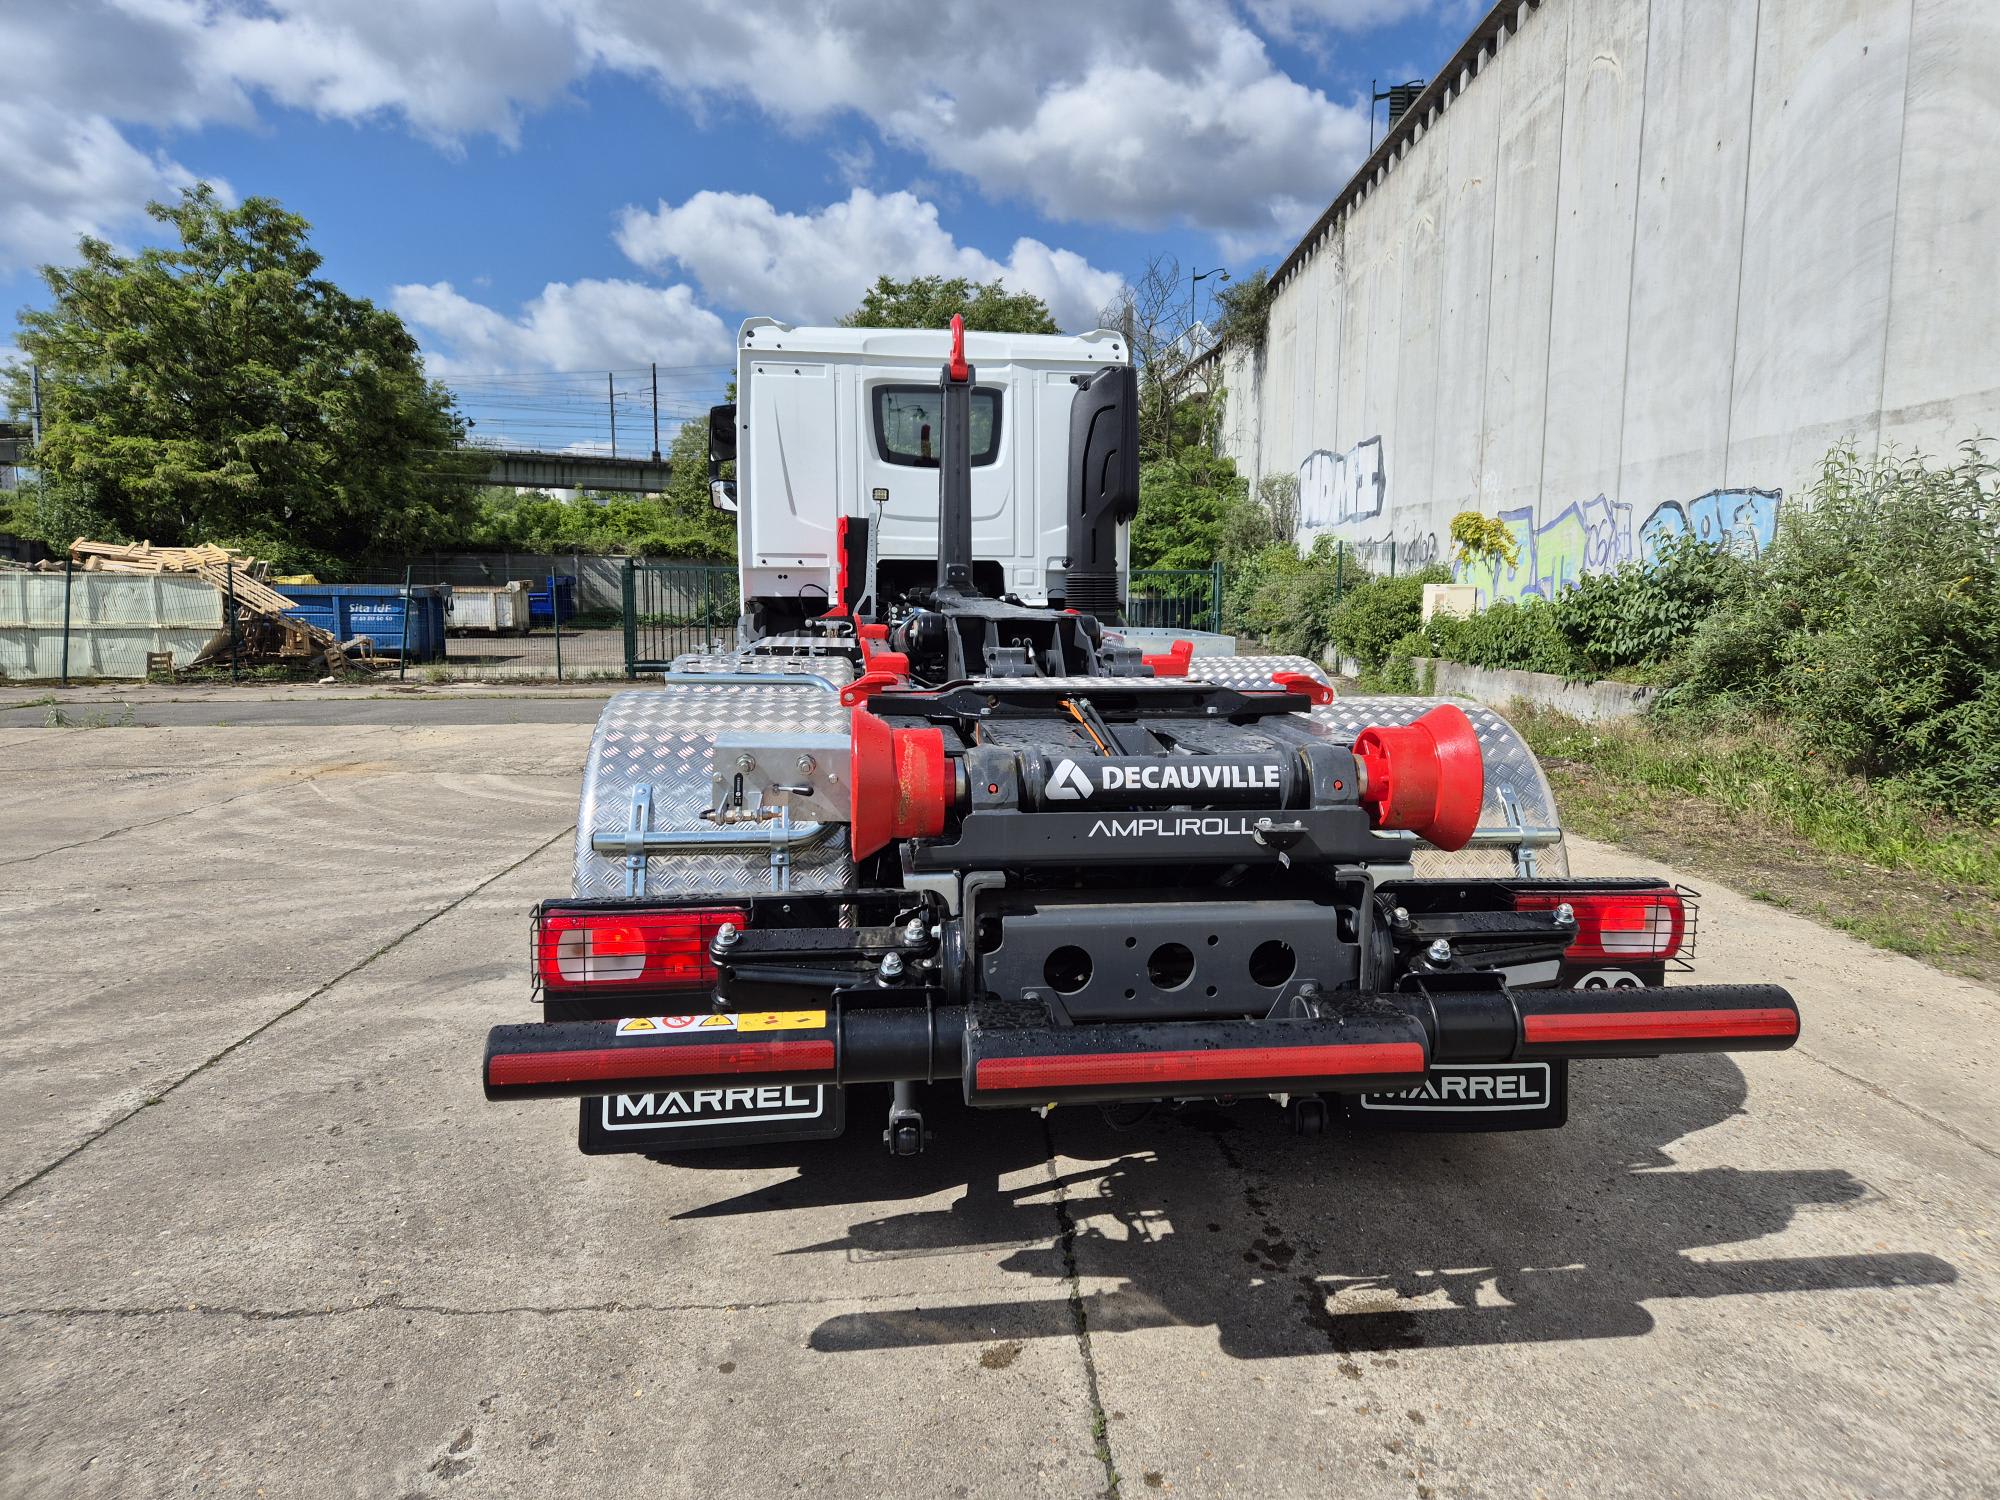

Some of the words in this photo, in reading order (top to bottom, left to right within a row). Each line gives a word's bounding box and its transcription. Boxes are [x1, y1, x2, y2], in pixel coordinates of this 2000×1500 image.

[349, 603, 370, 613] Sita
[1101, 765, 1280, 790] DECAUVILLE
[1373, 1075, 1540, 1100] ARREL
[616, 1085, 810, 1117] MARREL
